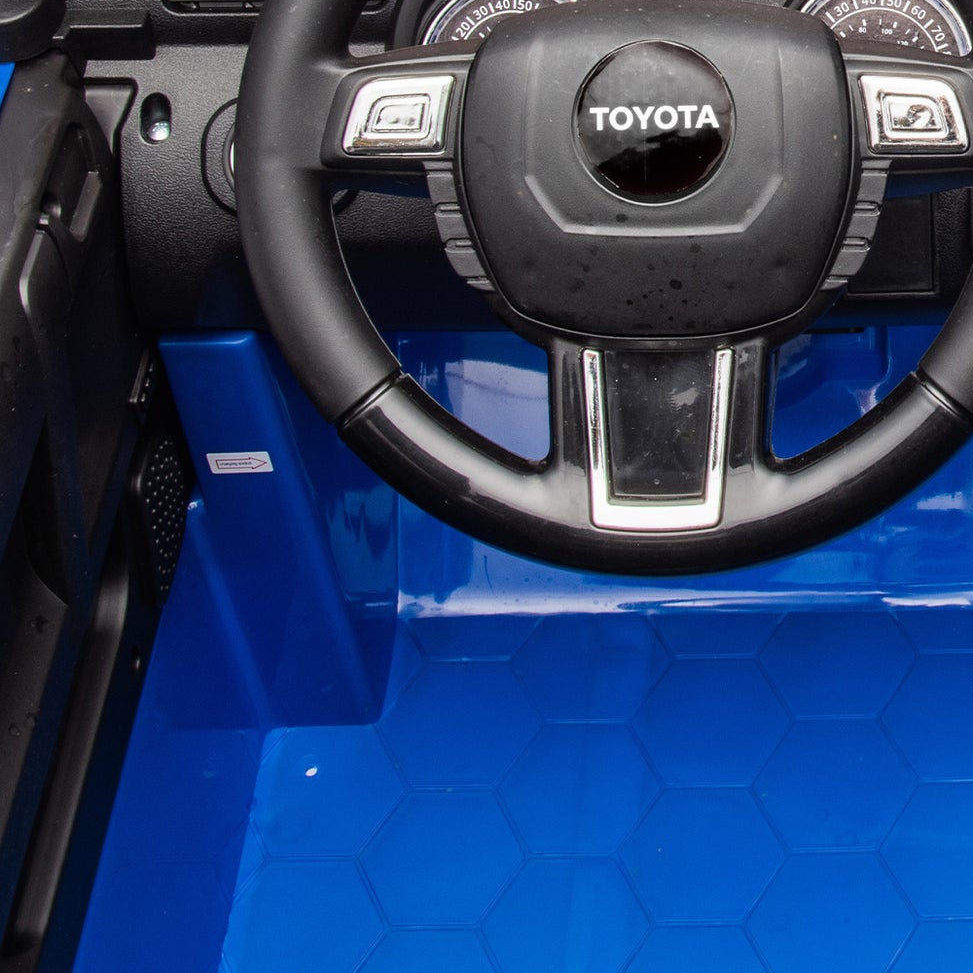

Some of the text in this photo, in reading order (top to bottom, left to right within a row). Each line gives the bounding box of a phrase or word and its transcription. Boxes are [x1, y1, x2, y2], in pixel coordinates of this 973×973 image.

[456, 0, 533, 37] 20 30 40 50
[834, 3, 850, 17] 30
[911, 5, 926, 20] 60
[932, 24, 946, 42] 70
[589, 105, 720, 131] TOYOTA
